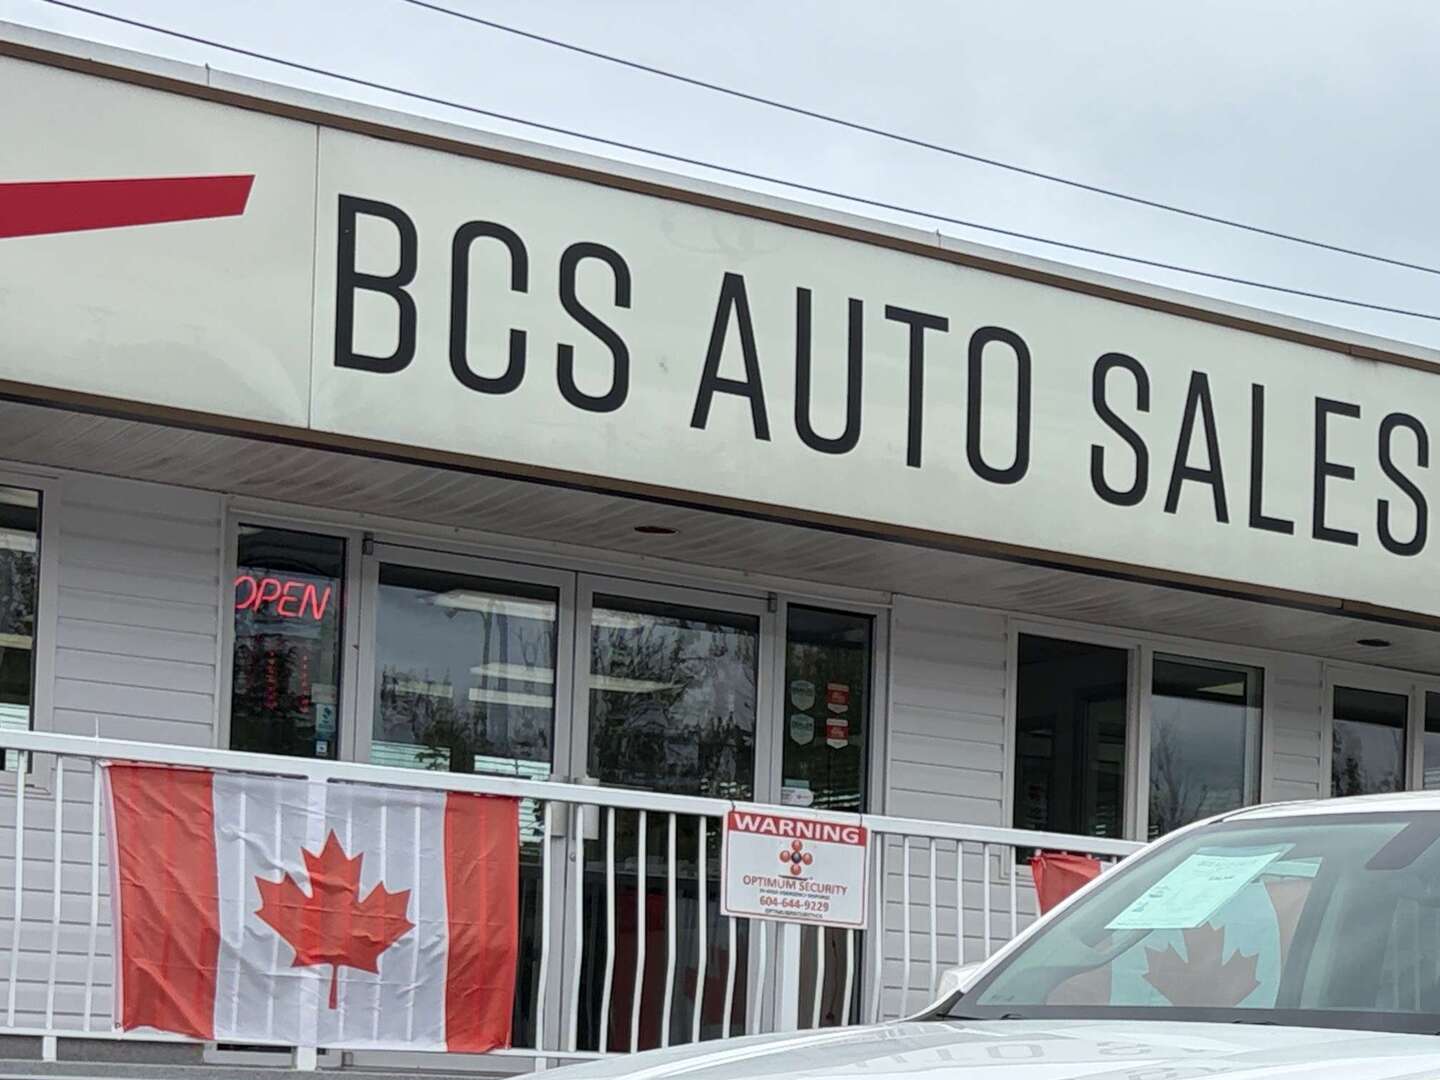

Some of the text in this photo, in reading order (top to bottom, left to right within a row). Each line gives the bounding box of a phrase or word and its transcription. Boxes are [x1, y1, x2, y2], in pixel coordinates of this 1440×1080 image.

[334, 194, 1428, 556] BCS AUTO SALES
[234, 575, 331, 620] OPEN
[733, 813, 860, 844] WARNING
[742, 874, 797, 892] OPTIMUM
[799, 880, 848, 896] SECURITY
[759, 895, 830, 913] 604-644-9229
